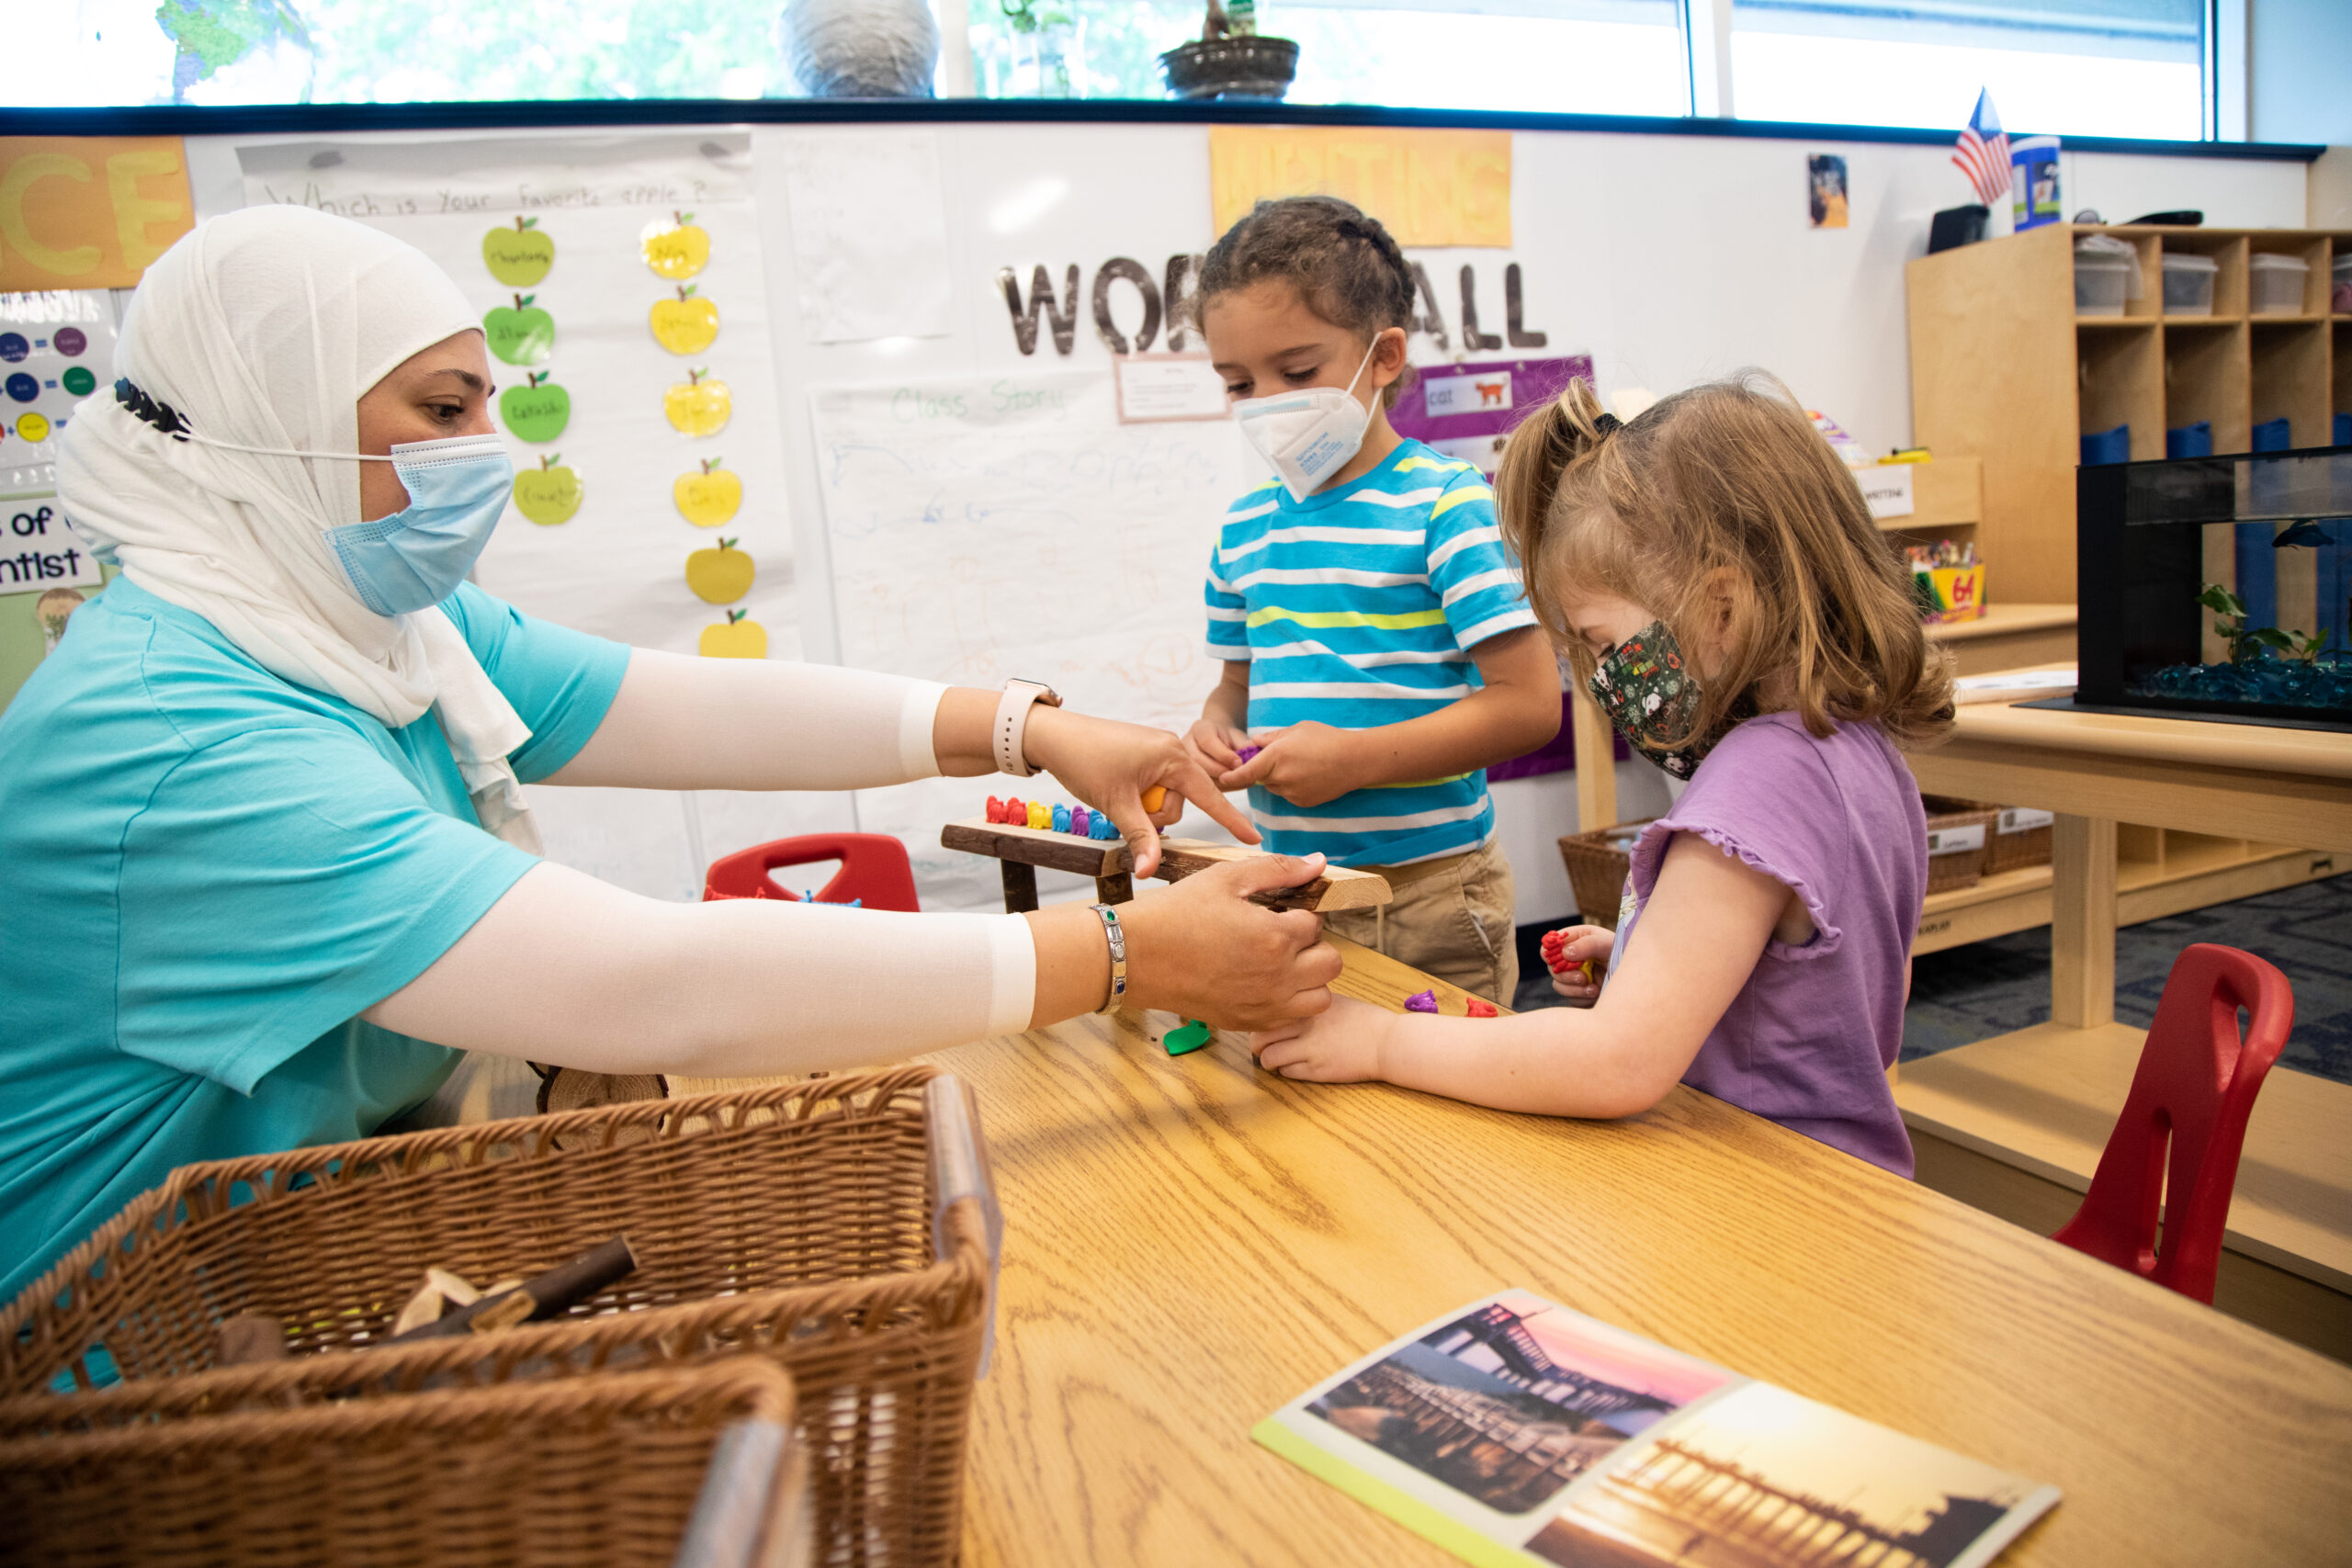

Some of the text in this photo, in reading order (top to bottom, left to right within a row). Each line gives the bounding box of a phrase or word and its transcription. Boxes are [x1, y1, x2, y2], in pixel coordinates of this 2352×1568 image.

[265, 182, 381, 217] Which
[396, 198, 417, 215] is
[891, 378, 1068, 423] Class Story
[1429, 387, 1454, 407] cat
[11, 506, 54, 537] of
[1952, 573, 1975, 603] 64
